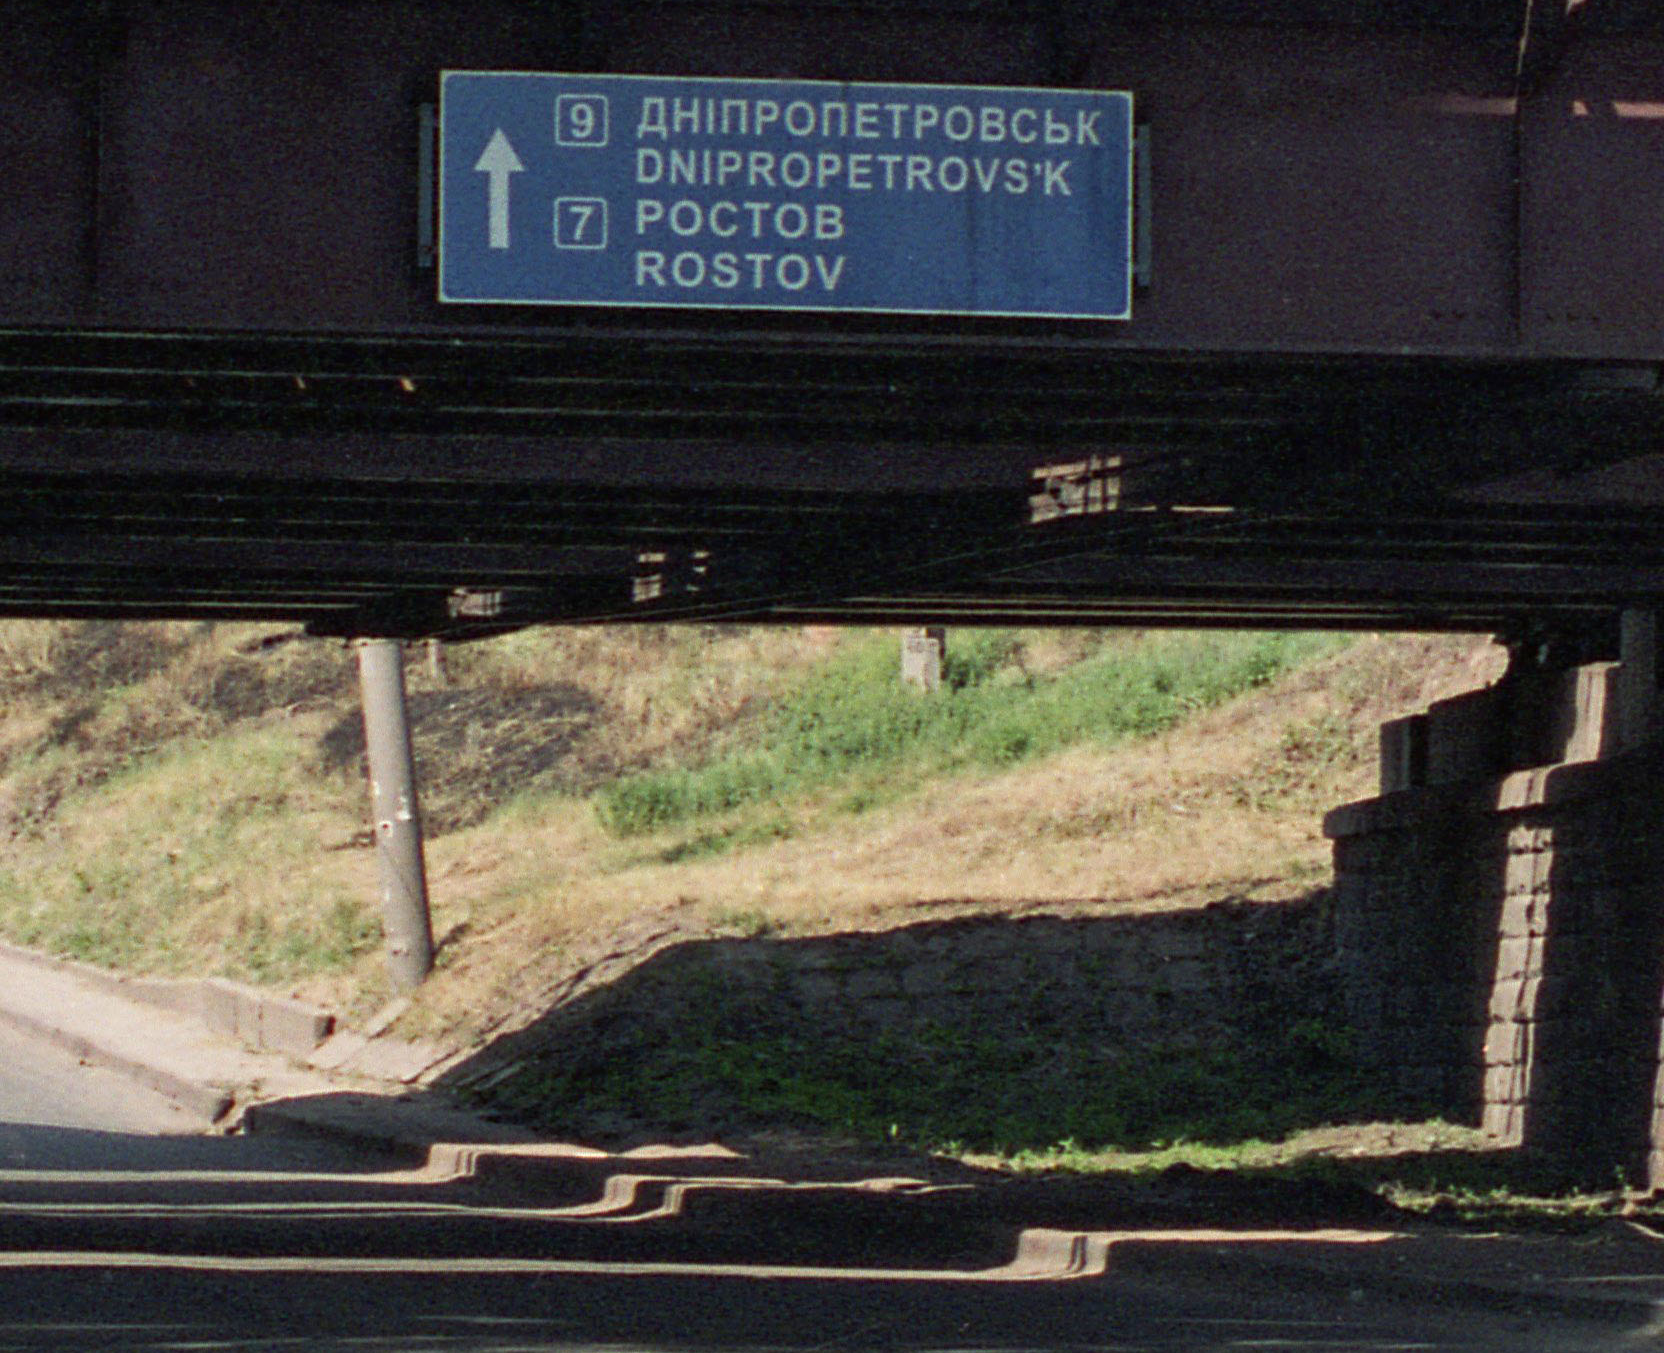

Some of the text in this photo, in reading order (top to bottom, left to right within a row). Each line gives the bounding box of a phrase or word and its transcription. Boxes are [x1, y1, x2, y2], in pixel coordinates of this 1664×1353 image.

[569, 96, 1102, 146] 9 ДНІПРОПЕТРОВСЬК
[568, 200, 845, 241] 7 РОСТОВ
[636, 250, 847, 291] ROSTOV
